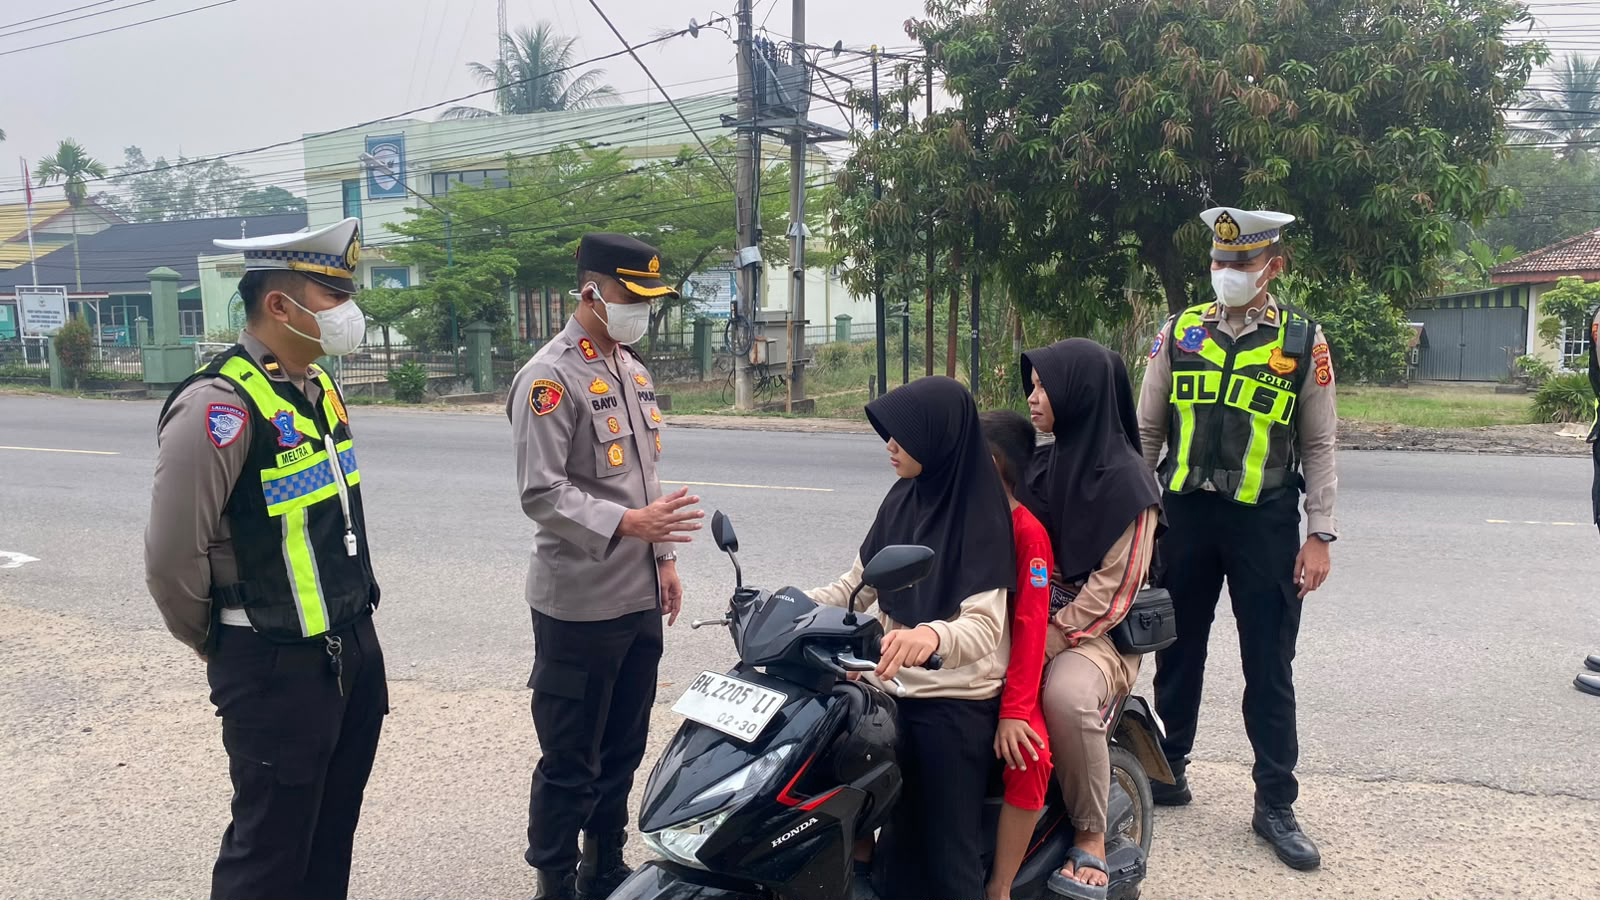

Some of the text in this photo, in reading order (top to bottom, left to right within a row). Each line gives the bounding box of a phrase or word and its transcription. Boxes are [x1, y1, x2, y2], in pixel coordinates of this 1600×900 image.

[1258, 373, 1291, 390] POLRI
[592, 396, 618, 411] BAYU
[282, 446, 309, 464] MELTRA
[711, 680, 753, 705] 2205
[771, 817, 819, 848] HONDA
